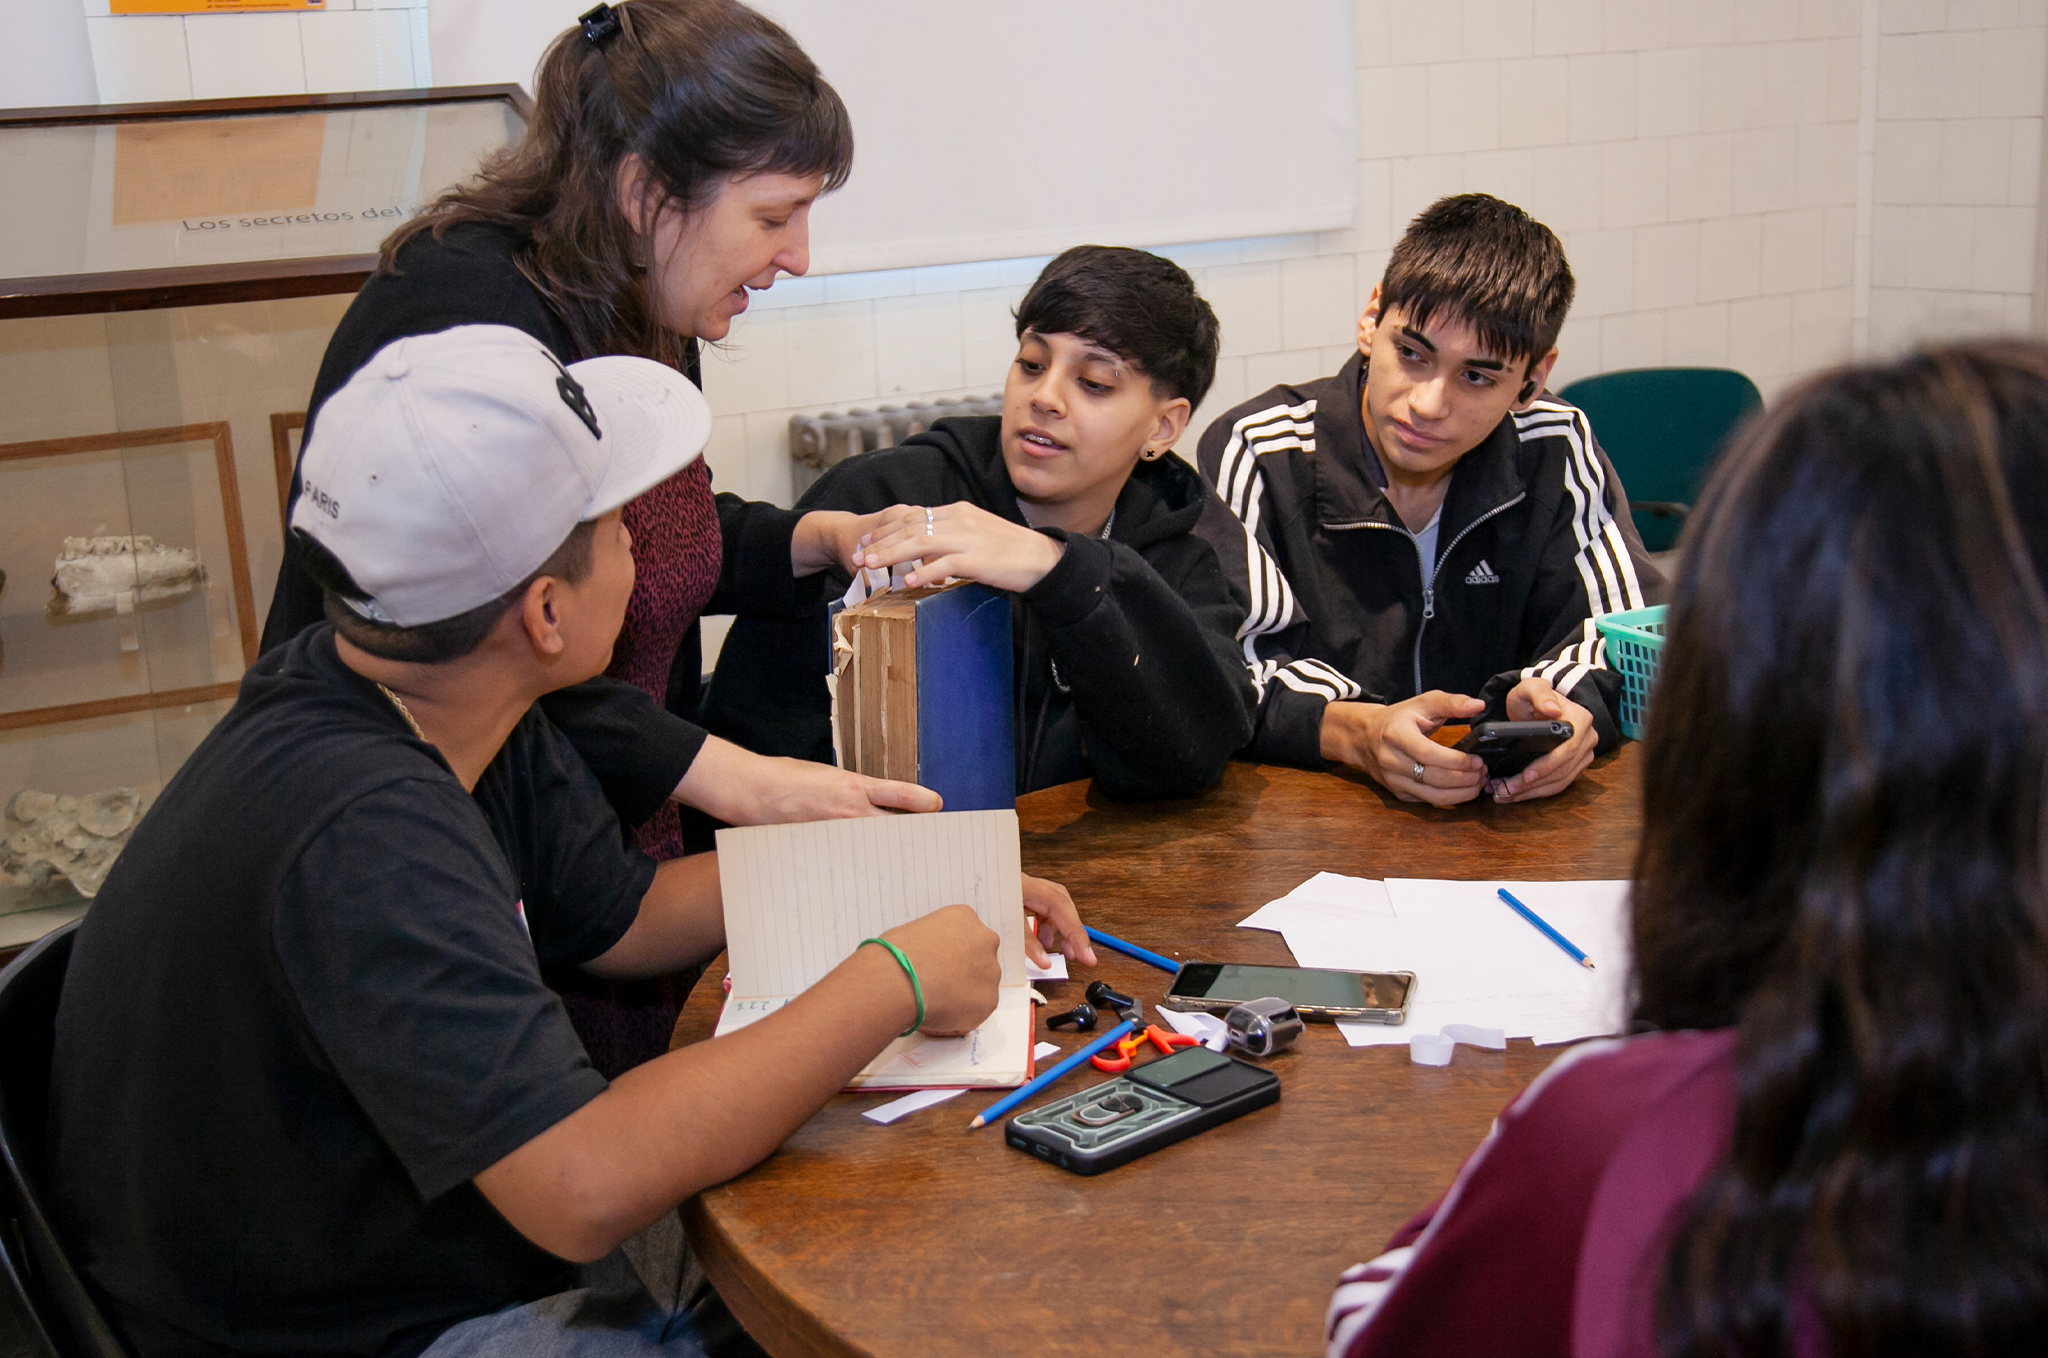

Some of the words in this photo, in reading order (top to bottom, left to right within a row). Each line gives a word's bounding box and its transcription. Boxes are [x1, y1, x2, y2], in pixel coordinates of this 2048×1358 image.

[183, 217, 231, 232] Los
[239, 208, 354, 229] secretos
[361, 205, 403, 220] del
[1465, 575, 1500, 584] adidas
